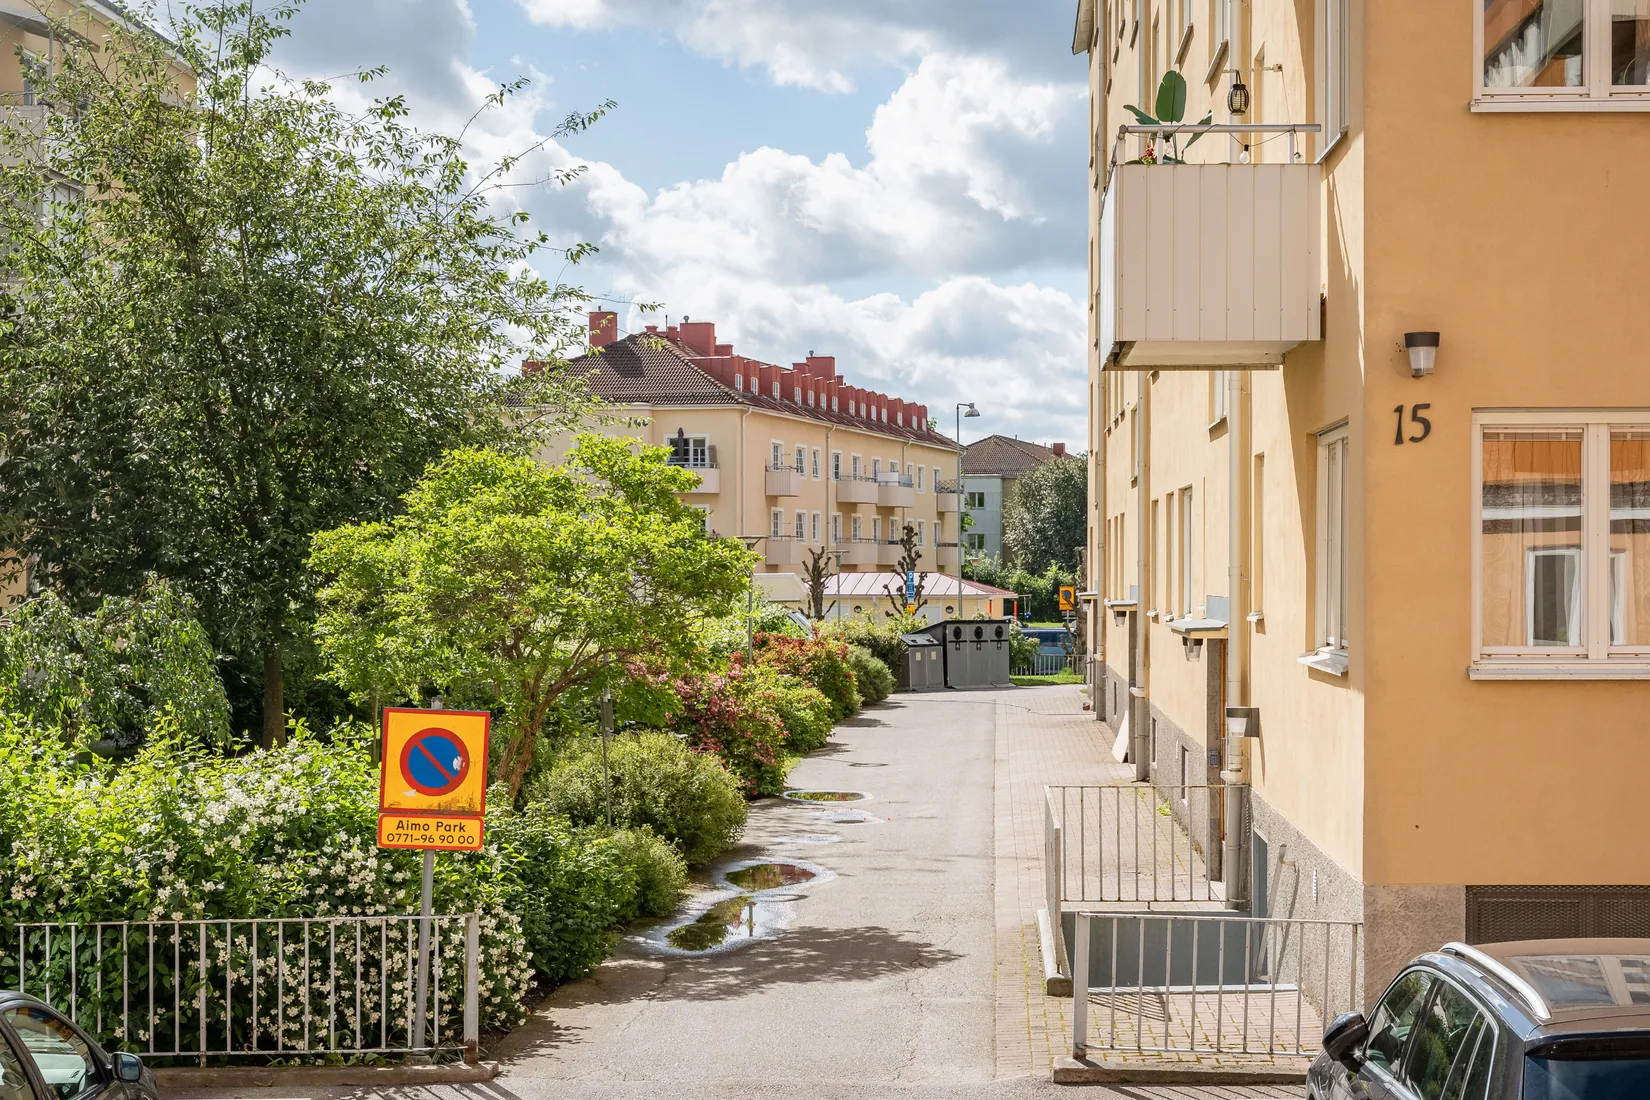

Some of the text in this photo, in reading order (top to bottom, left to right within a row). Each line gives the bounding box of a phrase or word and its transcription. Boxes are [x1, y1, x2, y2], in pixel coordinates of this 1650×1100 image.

[1393, 403, 1432, 446] 15
[395, 819, 467, 833] Aimo Park
[386, 832, 475, 844] 0771-96 90 00
